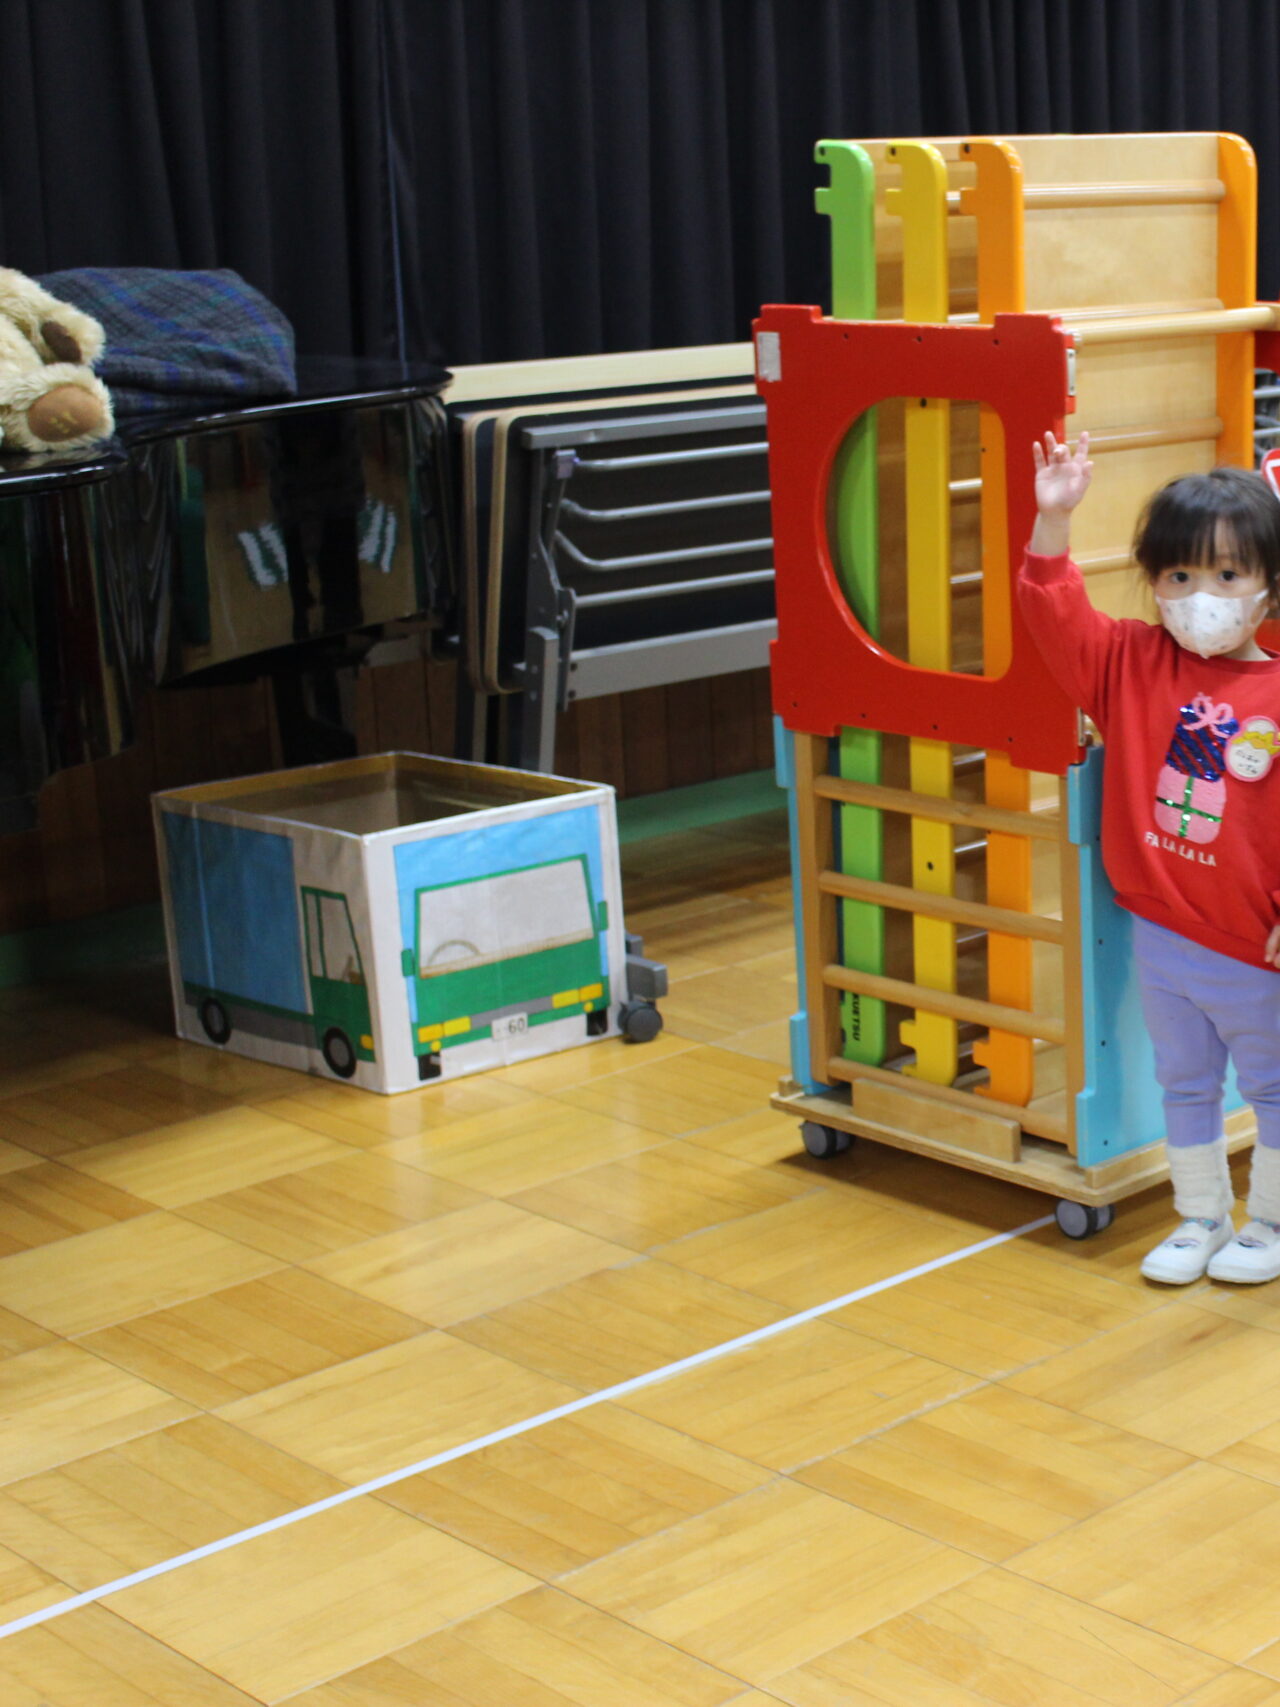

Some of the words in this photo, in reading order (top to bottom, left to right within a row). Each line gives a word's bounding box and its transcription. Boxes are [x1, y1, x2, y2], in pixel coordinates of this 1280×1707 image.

[1144, 831, 1159, 848] FA
[1162, 837, 1177, 853] LA
[1178, 845, 1195, 861] LA
[1198, 852, 1217, 867] LA
[508, 1016, 526, 1034] 60
